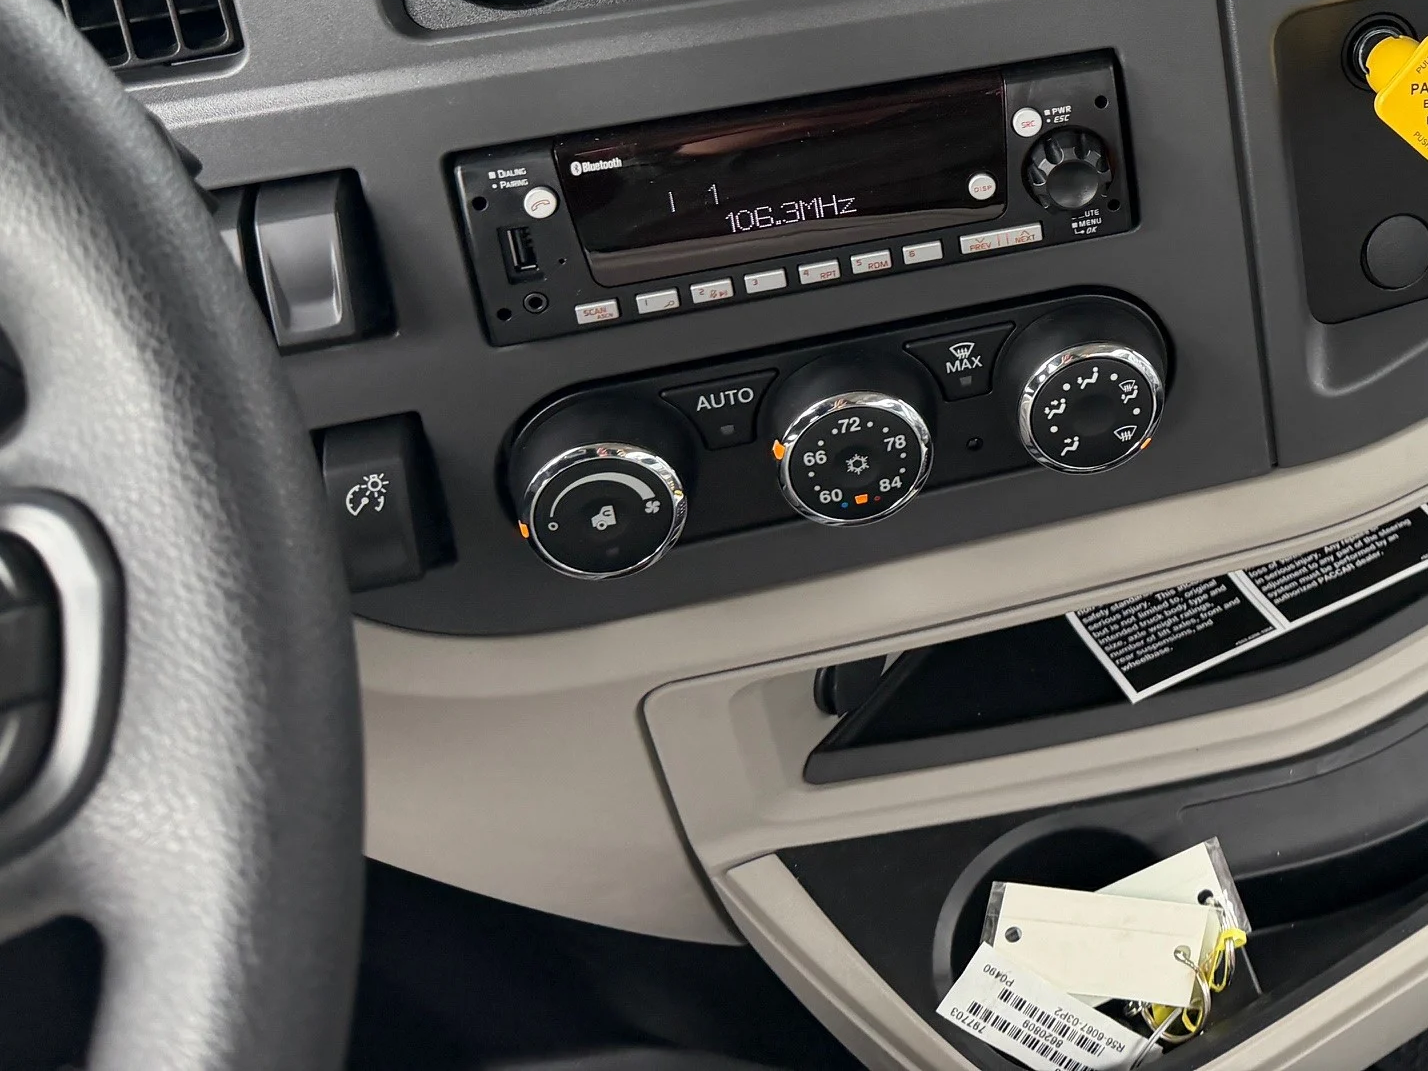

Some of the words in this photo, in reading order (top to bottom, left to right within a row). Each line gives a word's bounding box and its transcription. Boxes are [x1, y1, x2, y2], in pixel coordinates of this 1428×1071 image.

[1051, 105, 1072, 116] PWR
[1021, 120, 1036, 129] SRC
[1053, 114, 1071, 124] ESC
[582, 157, 622, 173] Bluetooth
[973, 184, 993, 193] DISP
[725, 194, 858, 233] 106.3MHz
[1079, 217, 1102, 227] MENU
[969, 241, 993, 252] PREV
[1015, 234, 1037, 244] NEXT
[868, 260, 890, 270] RDM
[820, 270, 837, 280] RPT
[583, 306, 607, 317] SCAN
[945, 354, 983, 374] MAX
[696, 387, 755, 412] AUTO
[837, 417, 862, 434] 72
[883, 434, 907, 452] 78
[803, 450, 828, 466] 66
[878, 475, 903, 493] 84
[819, 488, 844, 505] 60
[1261, 566, 1308, 591] adjustment
[1363, 534, 1378, 544] the
[1378, 518, 1411, 536] steering
[1299, 570, 1320, 584] must
[1333, 544, 1376, 568] performed
[1273, 580, 1318, 604] authorized
[1317, 563, 1355, 584] PACCAR
[1092, 627, 1109, 638] but
[1120, 615, 1136, 626] not
[1137, 600, 1169, 618] limited
[1184, 579, 1217, 597] original
[1223, 597, 1240, 609] and
[1098, 623, 1138, 644] intended
[1139, 613, 1163, 627] truck
[1163, 603, 1186, 616] body
[1188, 593, 1208, 605] type
[1210, 584, 1226, 596] and
[1196, 618, 1213, 630] and
